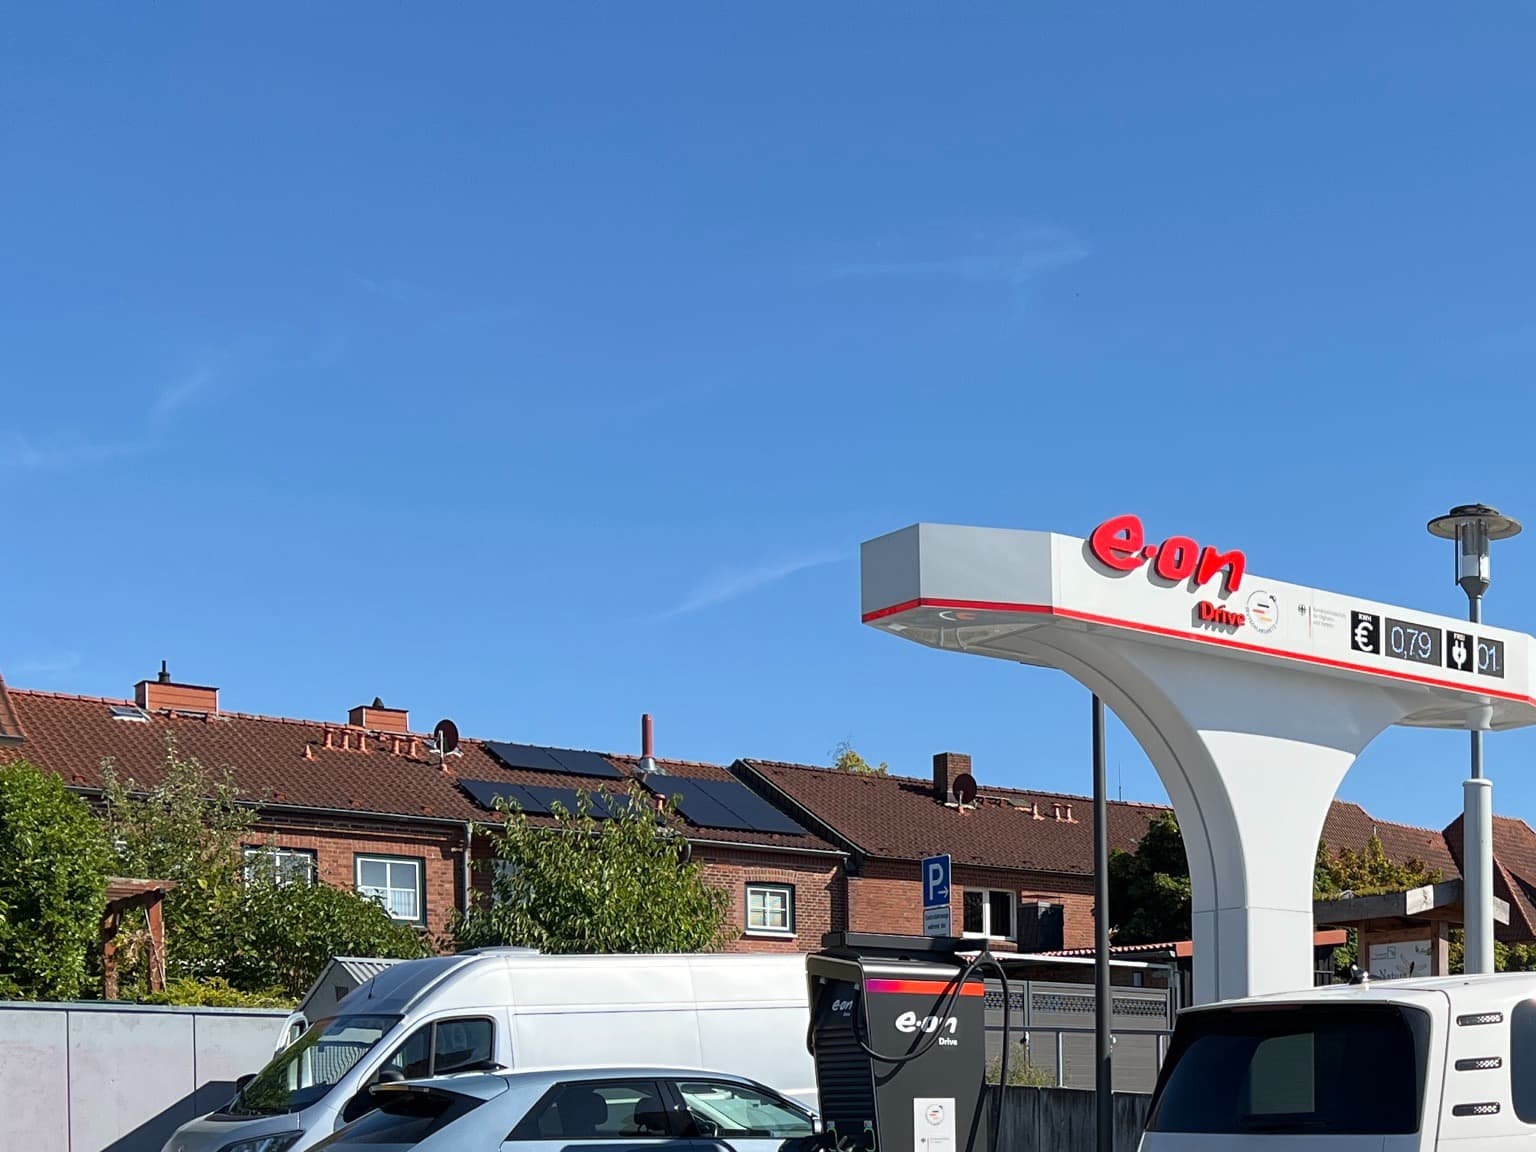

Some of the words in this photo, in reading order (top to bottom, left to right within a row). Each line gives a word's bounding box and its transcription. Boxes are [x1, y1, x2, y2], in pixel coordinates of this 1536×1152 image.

[1199, 600, 1246, 627] Drive
[1478, 643, 1497, 672] 01
[929, 863, 944, 901] P
[938, 1037, 958, 1046] Drive
